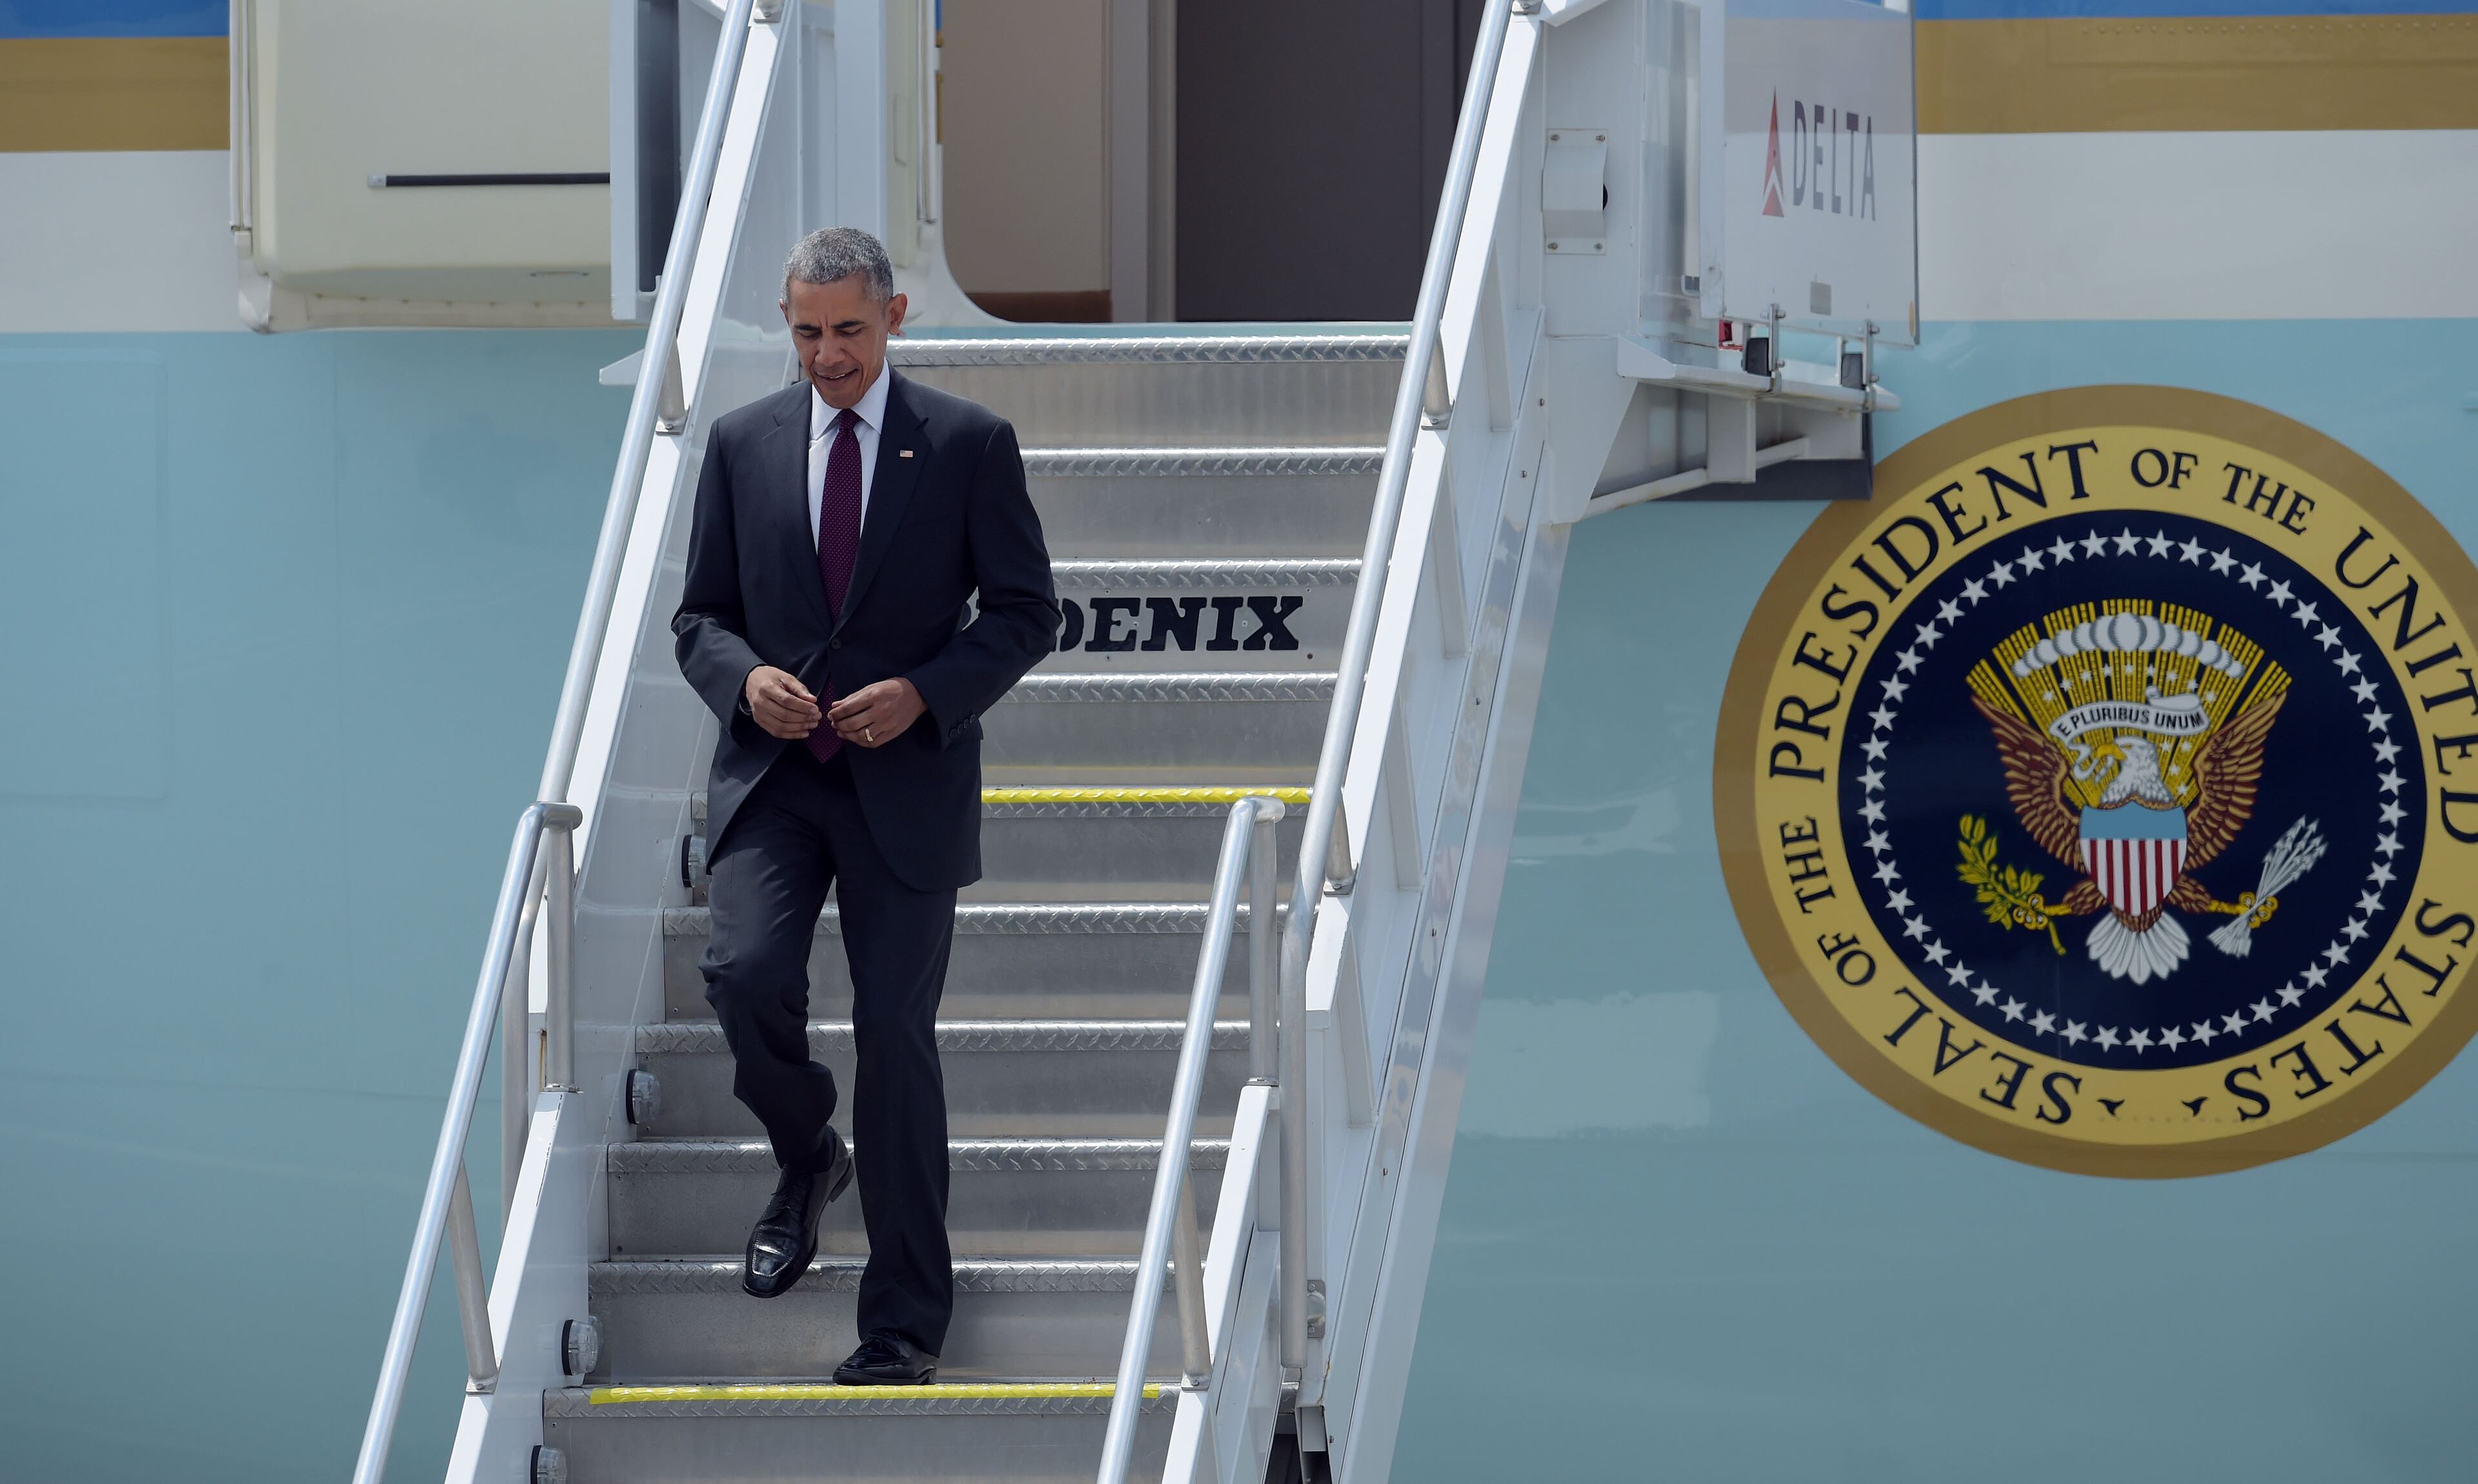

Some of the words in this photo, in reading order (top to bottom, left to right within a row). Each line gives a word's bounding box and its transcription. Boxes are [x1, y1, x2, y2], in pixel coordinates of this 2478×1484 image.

[1793, 100, 1876, 221] DELTA
[2131, 448, 2199, 489] OF
[2222, 461, 2316, 536] THE
[962, 596, 1304, 652] OENIX
[1769, 439, 2099, 783] PRESIDENT
[2057, 722, 2071, 737] E
[2070, 707, 2150, 730] PLURIBUS
[2155, 711, 2204, 730] UNUM
[2335, 526, 2478, 844] UNITED
[1779, 816, 1837, 915] THE
[1817, 932, 1877, 987] OF
[2224, 897, 2475, 1121] STATES
[1884, 987, 2082, 1125] SEAL
